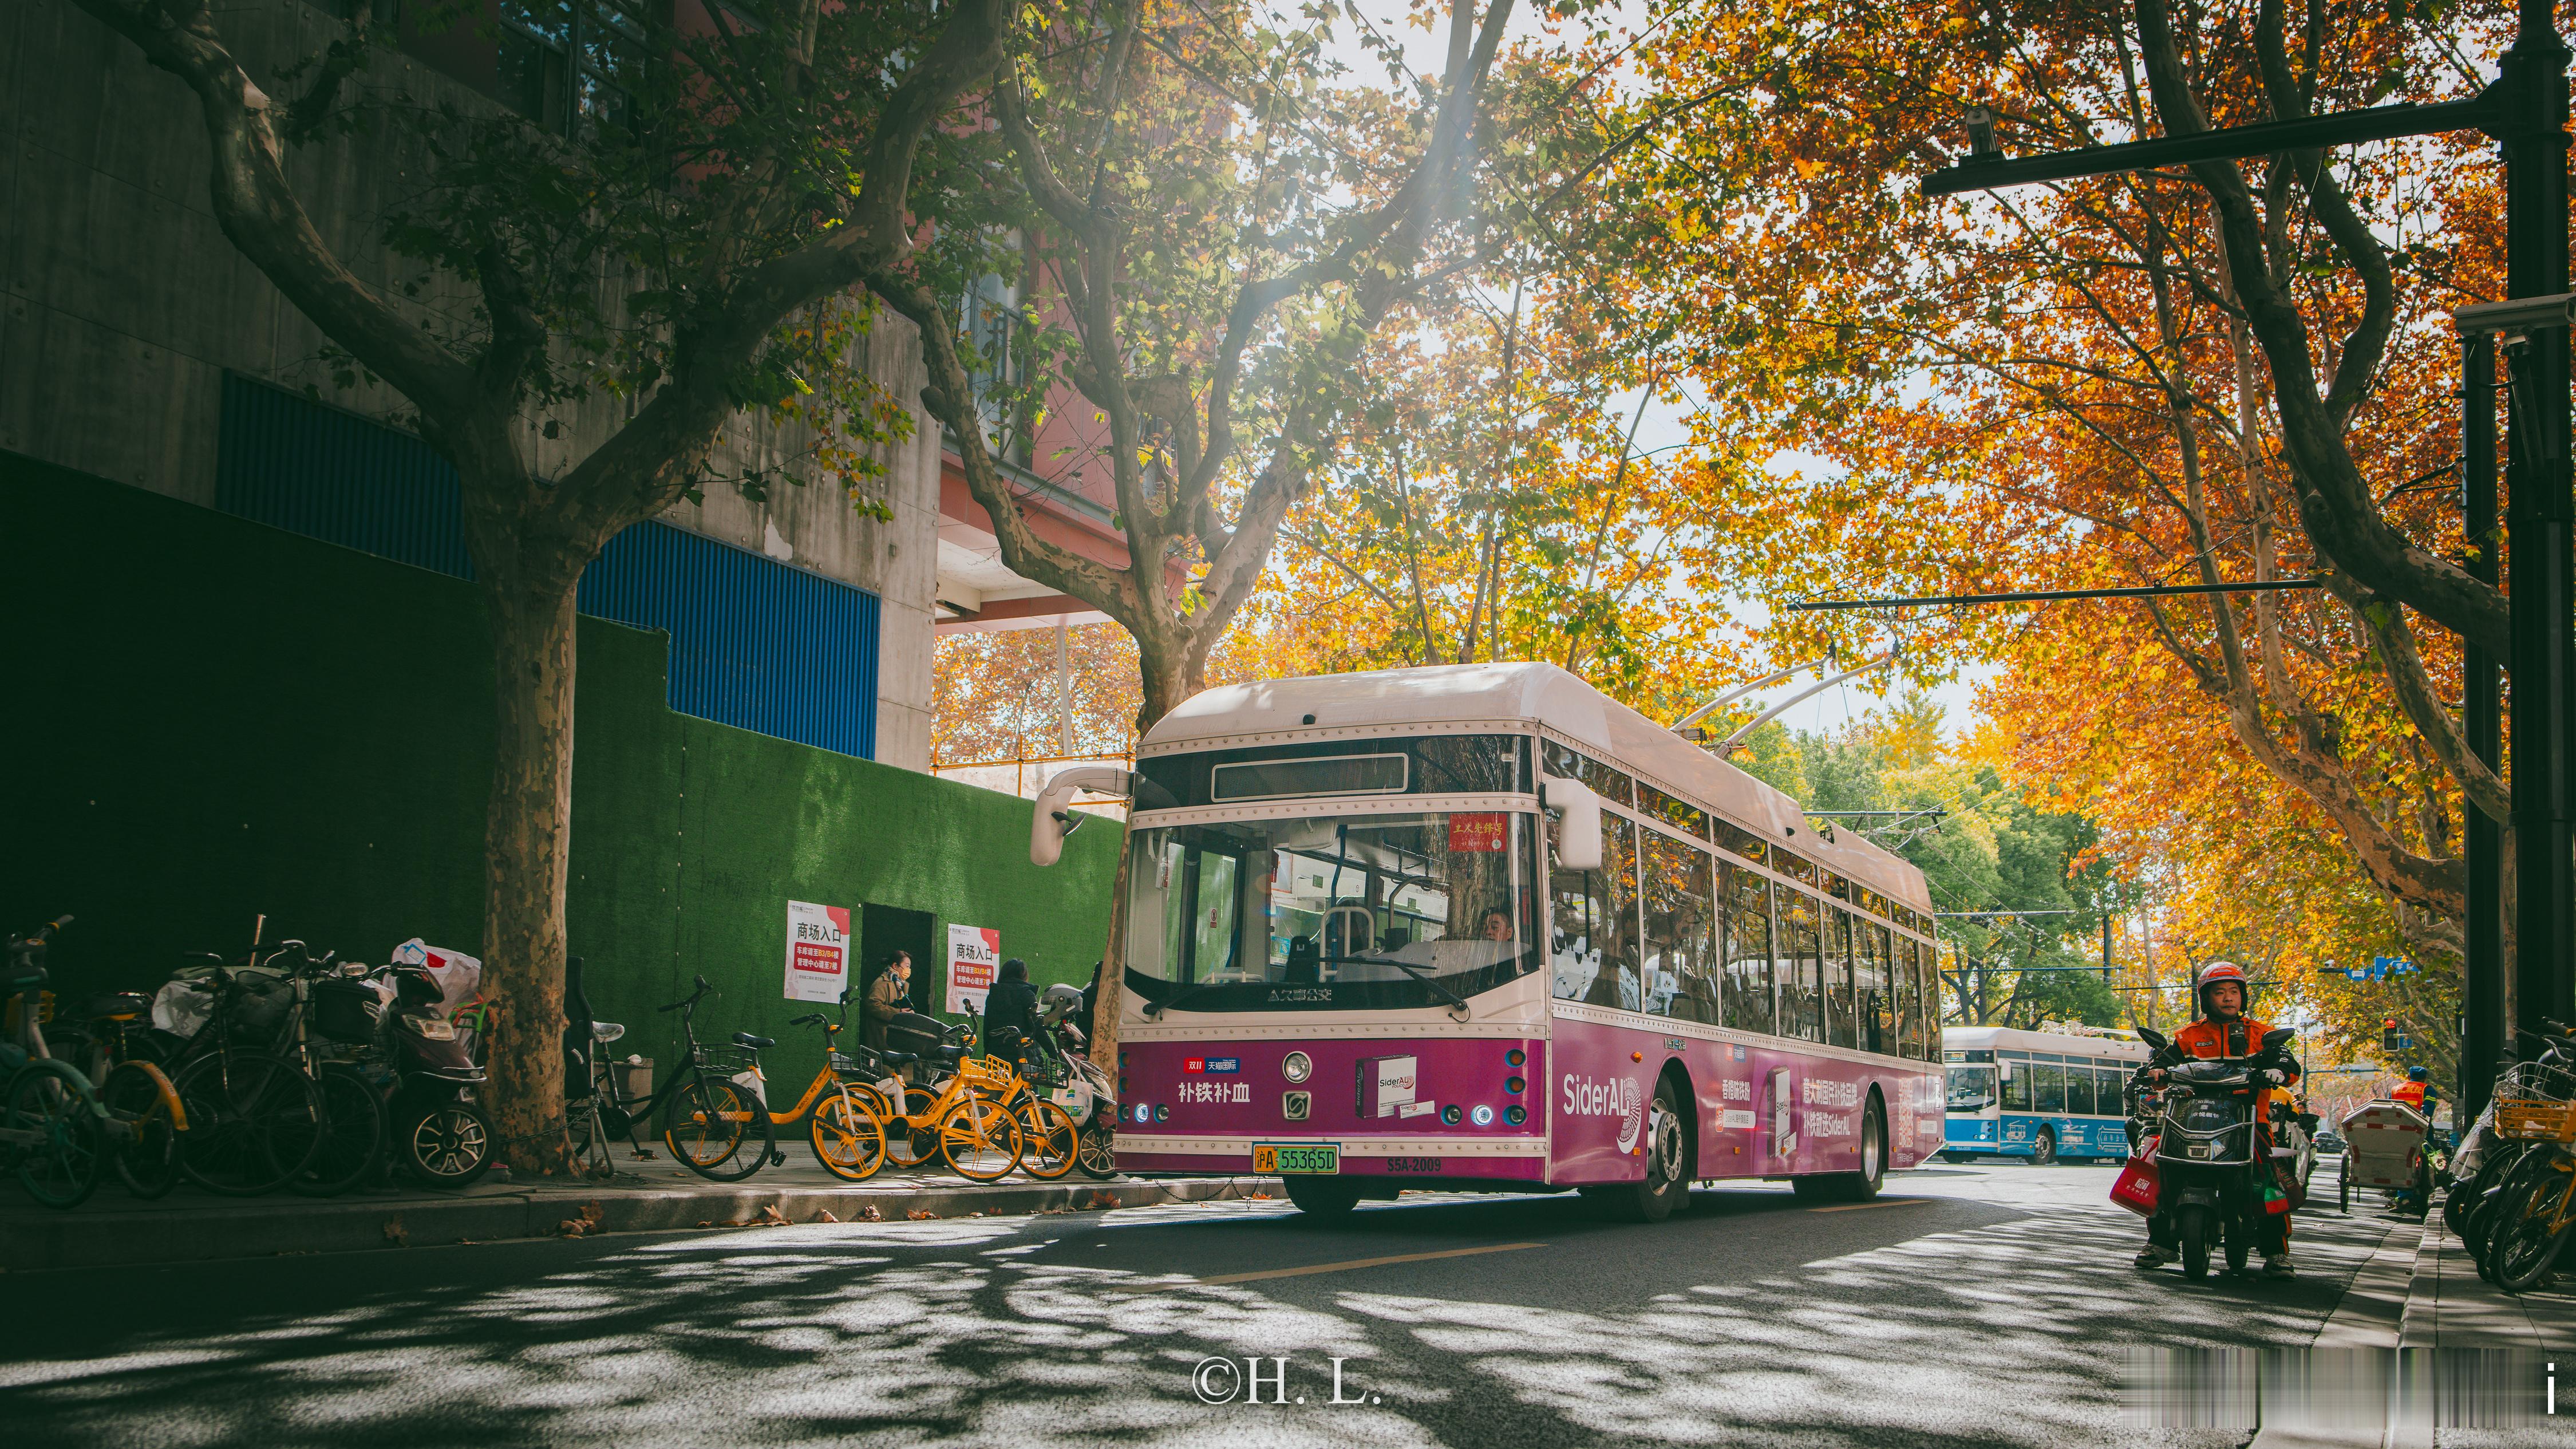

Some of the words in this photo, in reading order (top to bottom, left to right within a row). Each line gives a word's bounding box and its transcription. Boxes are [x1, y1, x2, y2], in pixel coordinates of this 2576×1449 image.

[797, 922, 841, 943] 商场入口
[797, 946, 839, 960] 车库请至B3/B4楼
[957, 943, 992, 961] 商场入口
[797, 958, 837, 970] 管理中心请至7楼
[956, 965, 991, 979] 车库请至B3/B4楼
[1188, 1061, 1202, 1069] 双11
[1208, 1061, 1236, 1070] 天猫国际
[1380, 1076, 1409, 1087] SiderAL
[1722, 1079, 1751, 1101] 香橙味铁粉
[1178, 1082, 1250, 1103] 补铁补血
[1563, 1073, 1629, 1116] SiderAL
[1803, 1077, 1858, 1107] 意大利国民补铁品牌
[1803, 1111, 1850, 1138] 补铁就选SiderAL
[1257, 1150, 1274, 1168] 沪A
[1281, 1150, 1335, 1170] 55365D
[1387, 1158, 1441, 1172] S5A-2009
